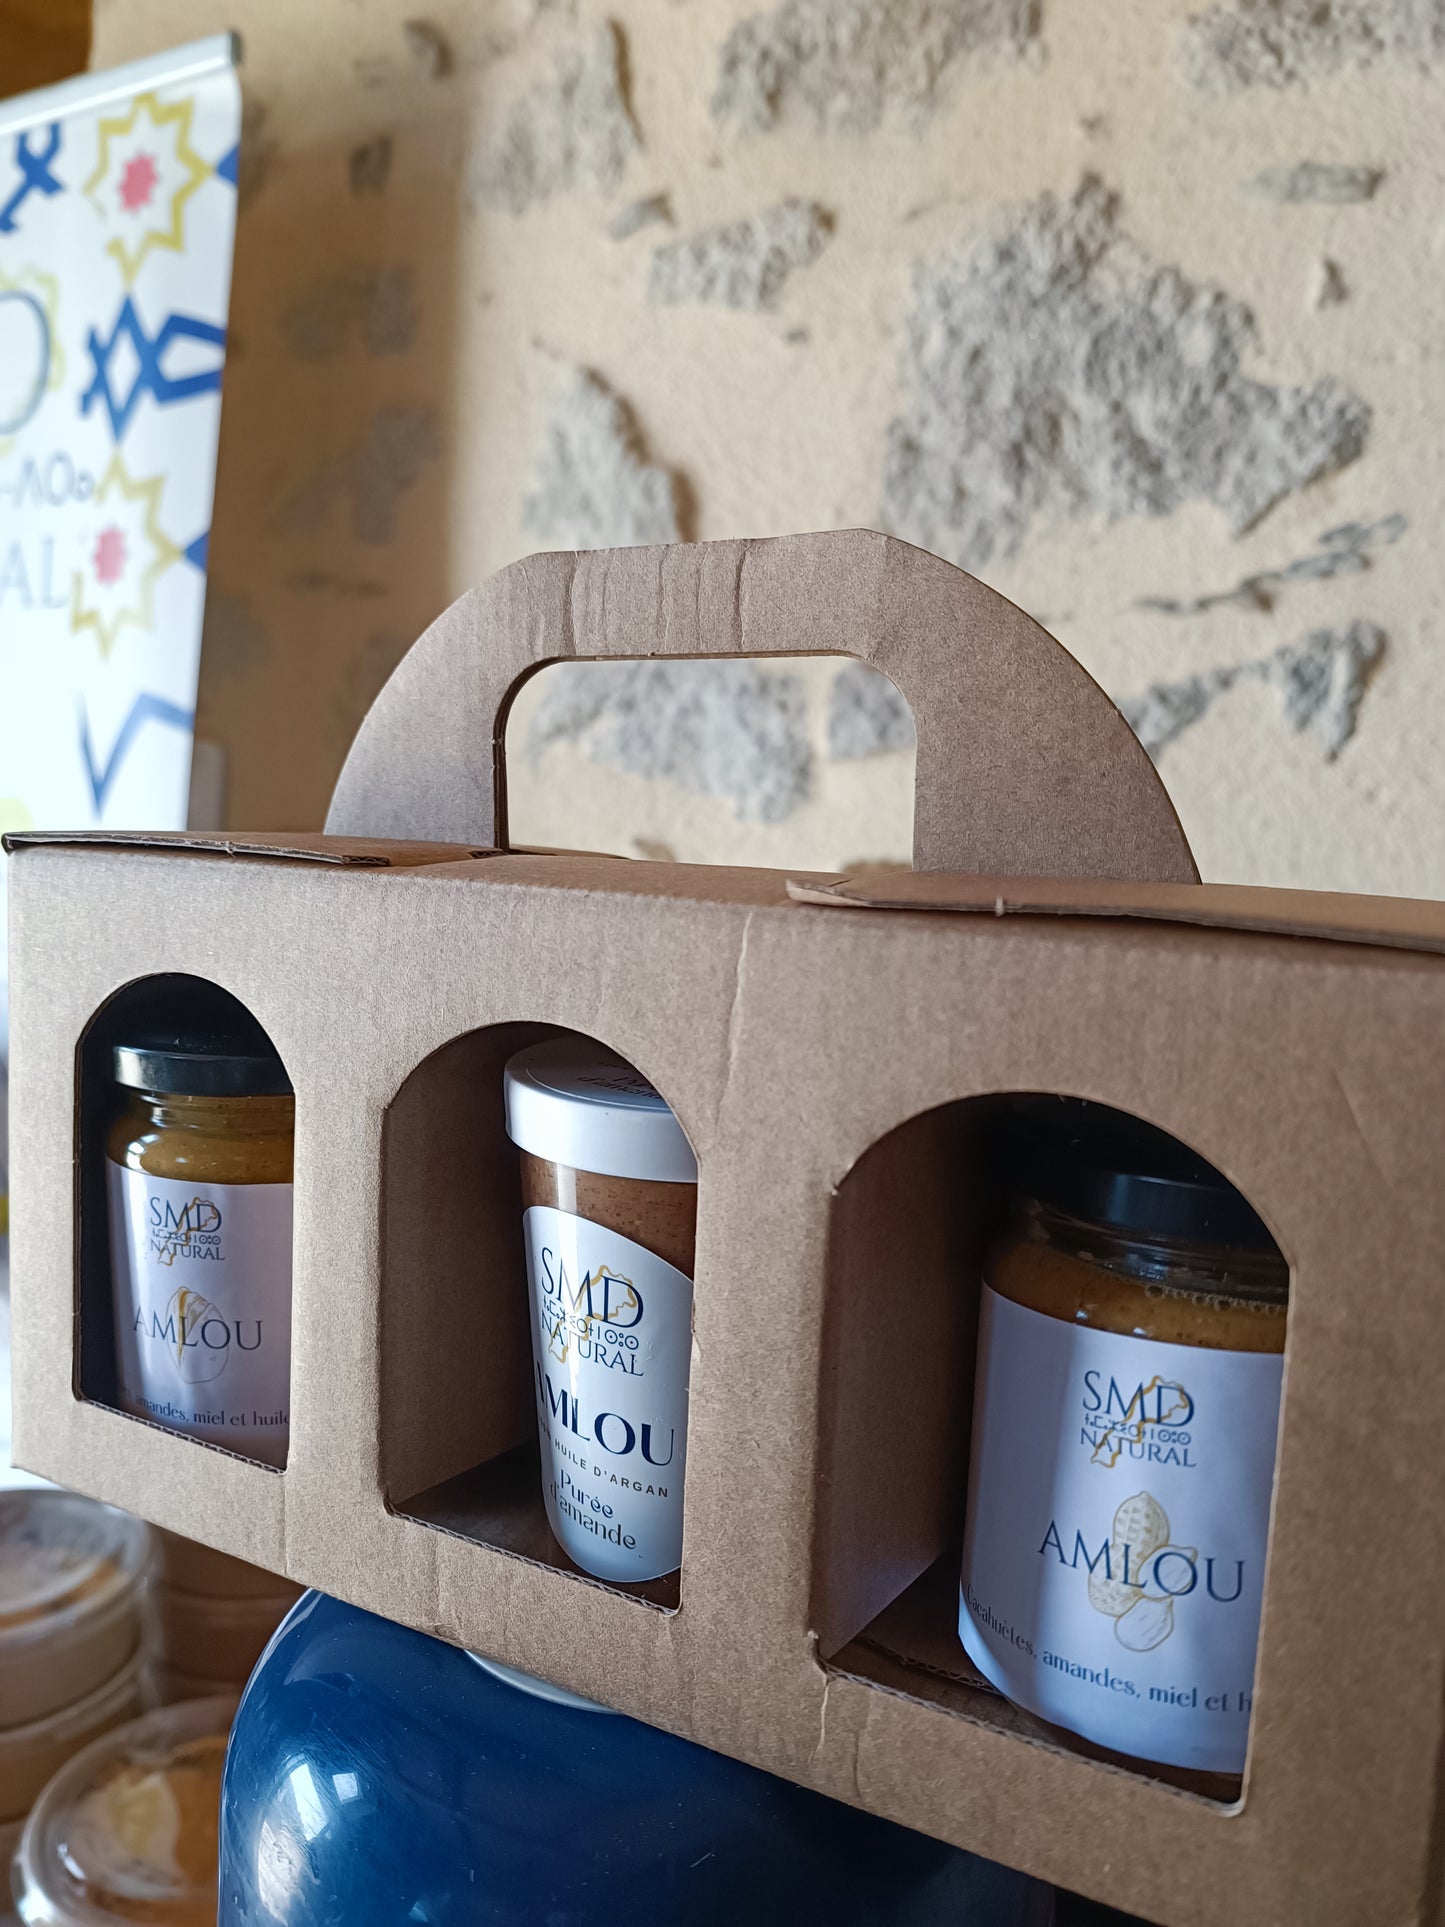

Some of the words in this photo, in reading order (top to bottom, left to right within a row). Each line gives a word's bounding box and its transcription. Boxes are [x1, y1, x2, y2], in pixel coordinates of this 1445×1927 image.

[150, 1196, 222, 1233] SMD
[150, 1238, 226, 1261] NATURAL
[541, 1246, 644, 1329] SMD
[133, 1305, 263, 1351] AMLOU
[541, 1309, 645, 1377] NATURAL
[193, 1410, 225, 1426] miel
[229, 1413, 247, 1427] et
[1082, 1369, 1195, 1428] SMD
[554, 1438, 588, 1470] HUILE
[593, 1465, 669, 1498] D'ARGAN
[1080, 1426, 1197, 1468] NATURAL
[550, 1481, 637, 1551] d'amande
[560, 1468, 614, 1519] Purée
[1038, 1519, 1246, 1602] AMLOU
[1043, 1650, 1141, 1698] amandes,
[1149, 1685, 1198, 1708] miel
[1204, 1692, 1230, 1713] et
